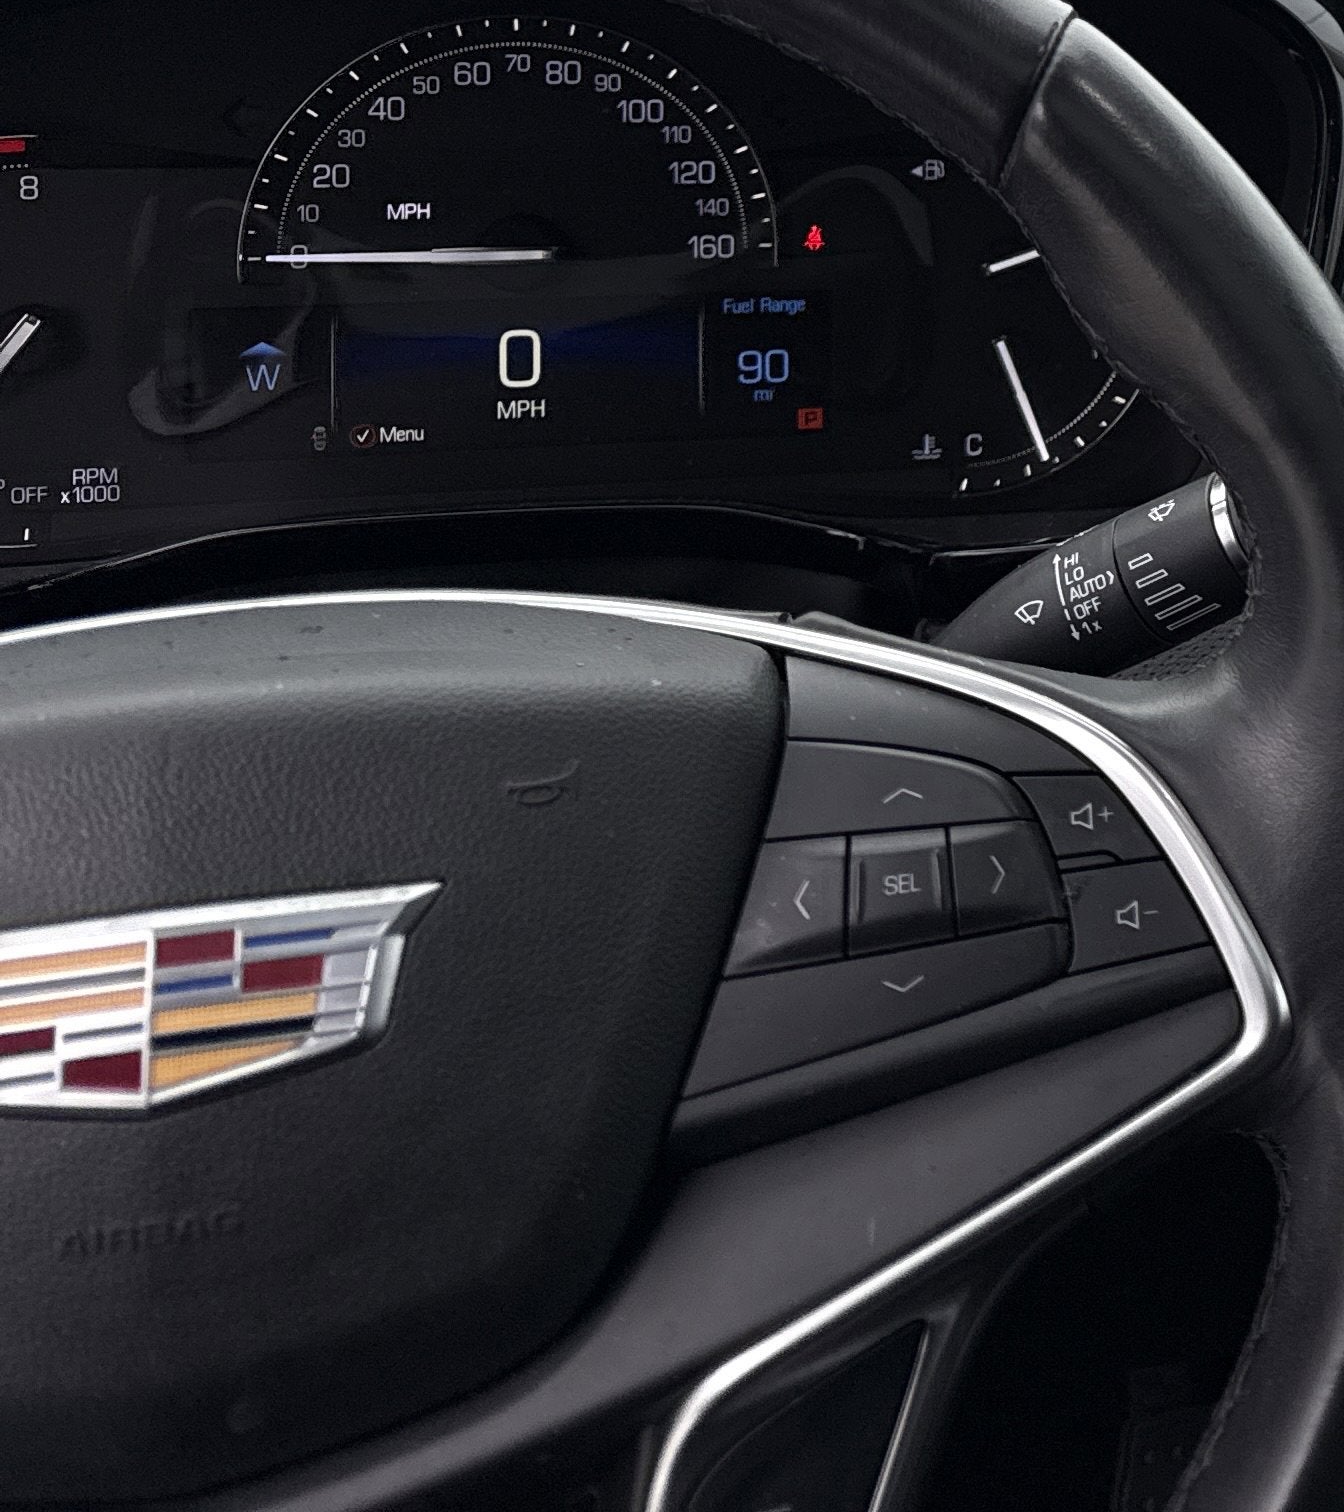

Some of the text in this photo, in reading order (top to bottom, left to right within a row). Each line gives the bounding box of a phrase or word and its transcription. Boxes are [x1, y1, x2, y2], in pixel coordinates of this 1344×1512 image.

[453, 61, 491, 86] 60
[504, 54, 532, 73] 70
[545, 60, 582, 85] 80
[412, 75, 440, 95] 50
[594, 74, 621, 92] 90
[367, 97, 405, 120] 40
[617, 99, 664, 123] 100
[337, 129, 366, 148] 30
[661, 125, 691, 143] 110
[312, 164, 350, 188] 20
[668, 160, 715, 185] 120
[20, 175, 39, 200] 8
[297, 204, 319, 223] 10
[387, 202, 431, 220] MPH
[695, 197, 729, 217] 140
[688, 234, 735, 259] 160
[723, 297, 806, 315] Fuel Range
[500, 329, 541, 388] 0
[738, 349, 789, 384] 90
[246, 364, 280, 391] W
[754, 389, 774, 401] mi
[497, 399, 546, 419] MPH
[380, 426, 424, 443] Menu
[966, 433, 983, 456] C
[72, 468, 118, 485] RPM
[11, 486, 48, 504] OFF
[60, 484, 120, 504] x1000
[1063, 552, 1080, 569] HI
[1064, 566, 1085, 585] LO
[1070, 574, 1107, 603] AUTO
[1073, 596, 1102, 620] OFF
[884, 873, 922, 896] SEL
